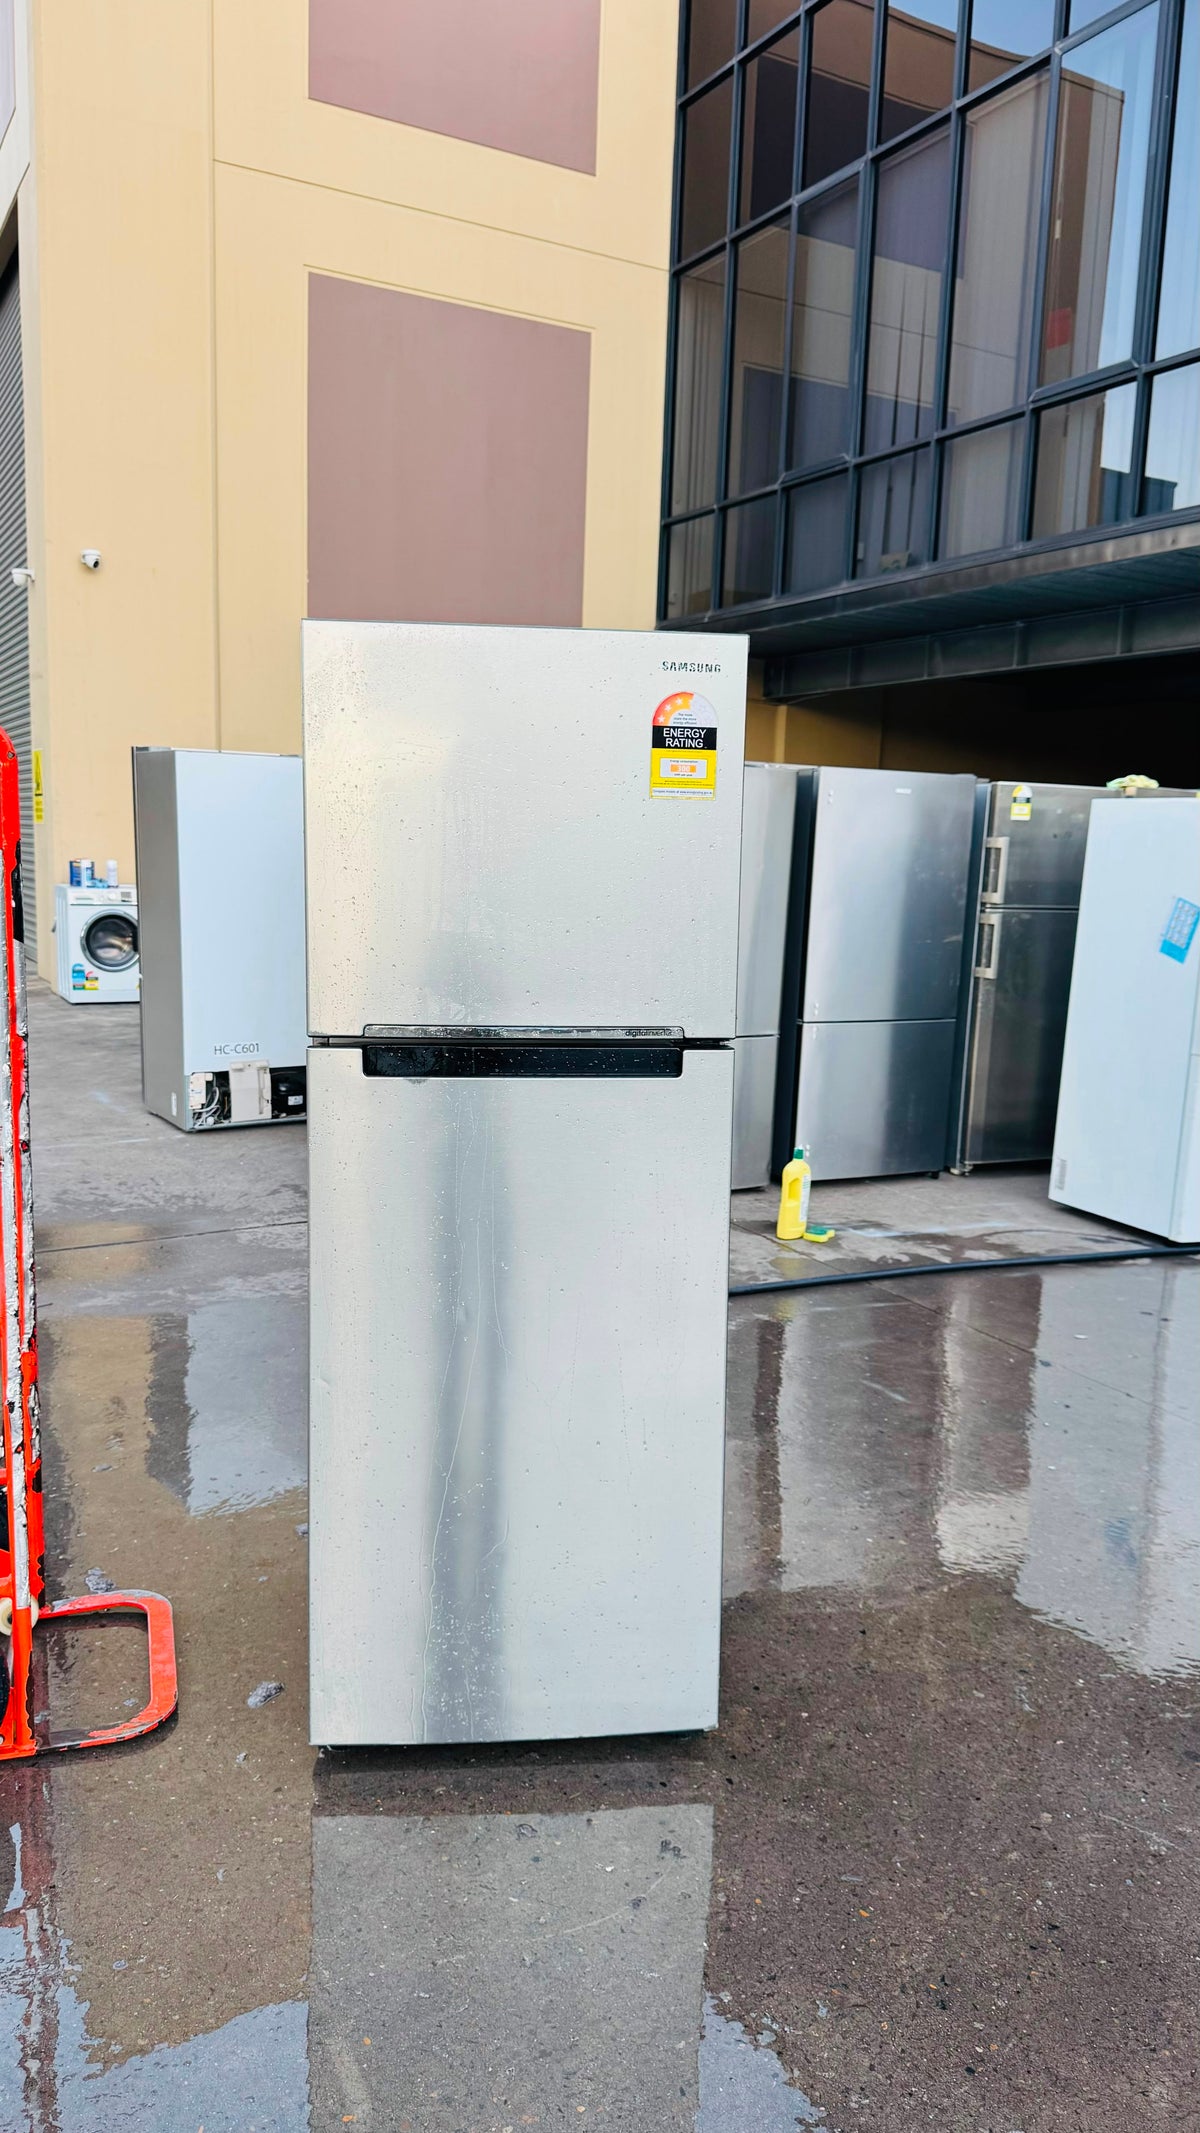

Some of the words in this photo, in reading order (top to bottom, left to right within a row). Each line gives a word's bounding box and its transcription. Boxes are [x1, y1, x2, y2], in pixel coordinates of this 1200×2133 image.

[662, 660, 721, 673] SAMSUNG
[663, 727, 706, 738] ENERGY
[665, 738, 704, 748] RATING
[214, 1043, 259, 1055] HC-C601
